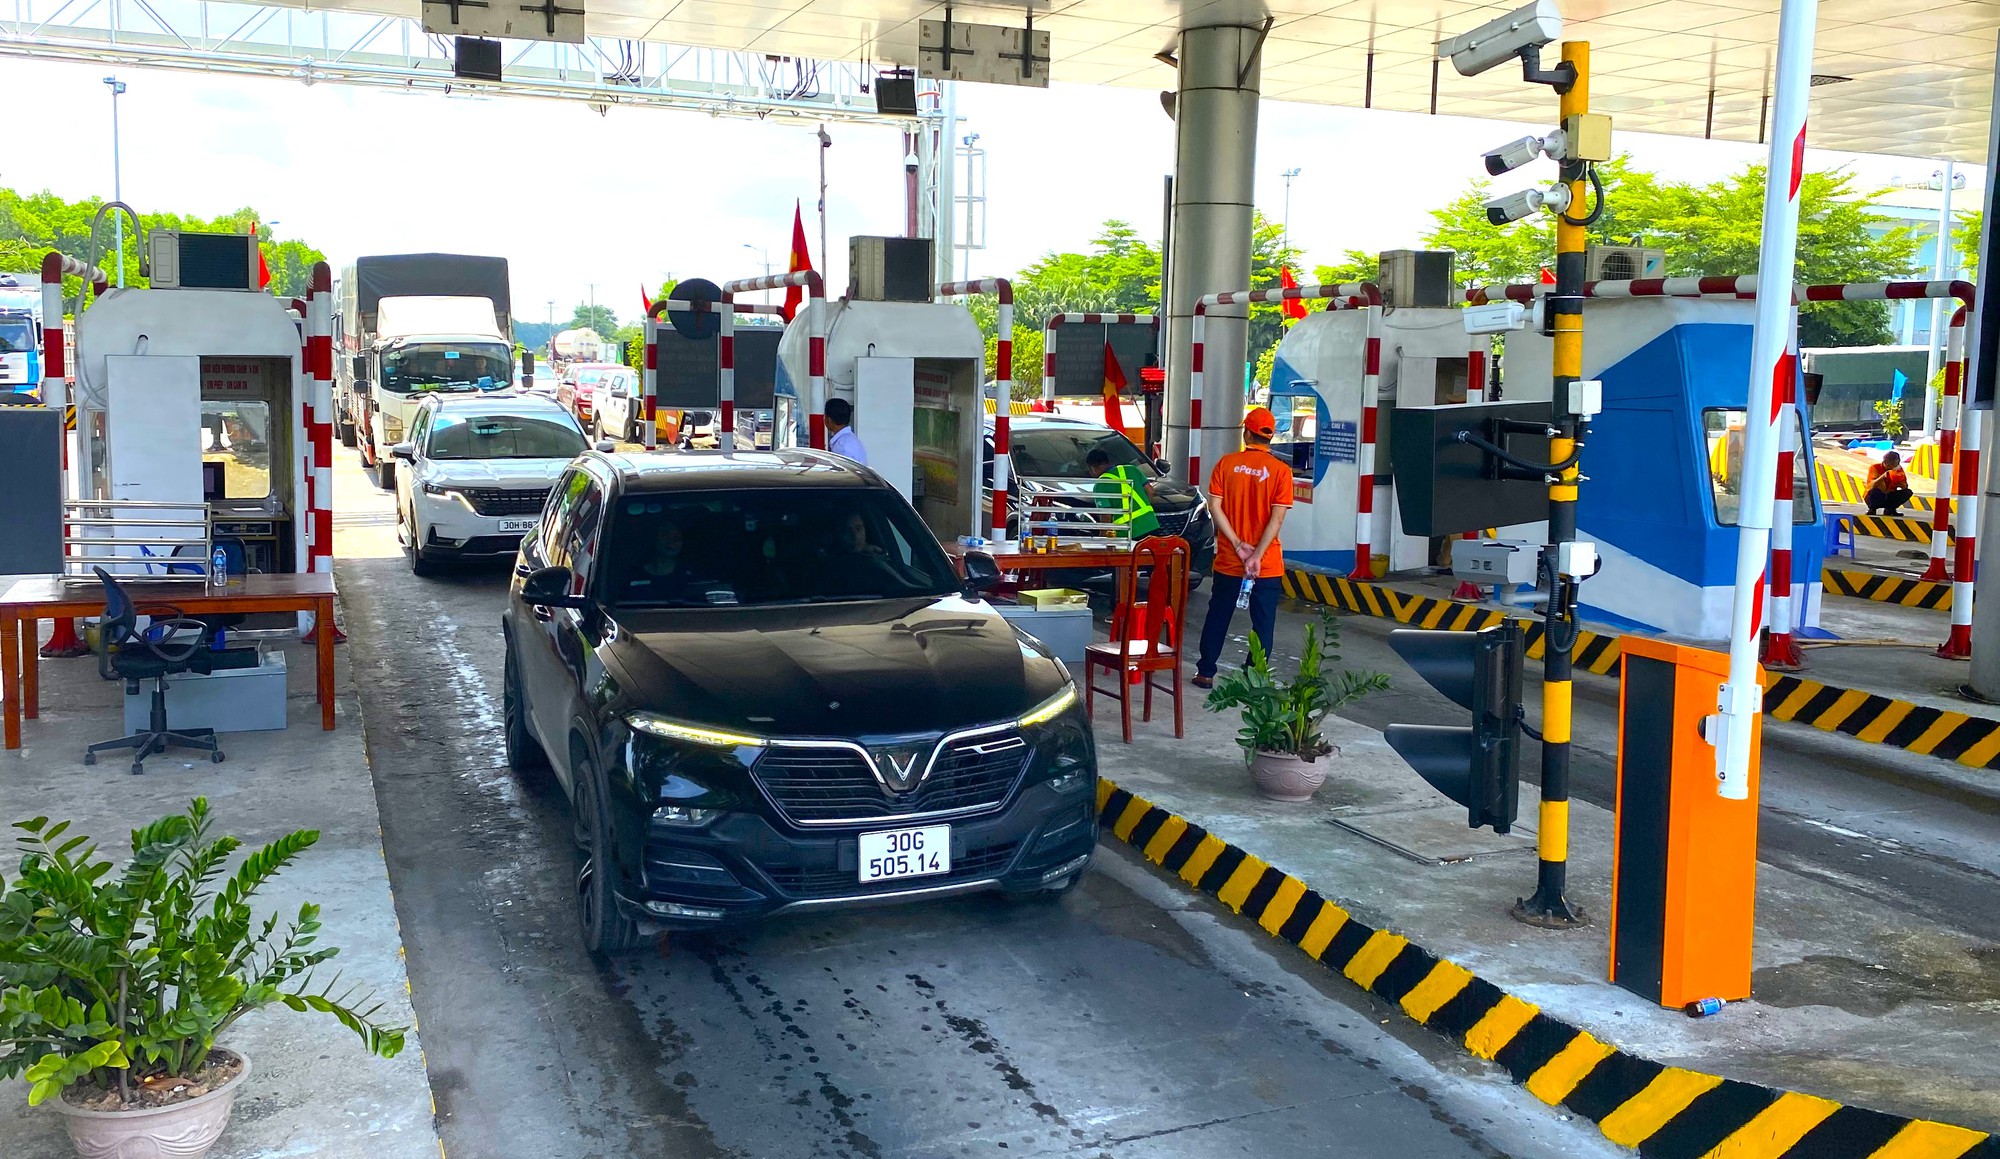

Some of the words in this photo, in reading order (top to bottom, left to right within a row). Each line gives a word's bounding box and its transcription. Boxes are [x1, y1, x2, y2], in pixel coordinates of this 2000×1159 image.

[1234, 464, 1263, 477] ePass
[504, 521, 520, 529] 30H
[886, 832, 924, 853] 30G
[870, 851, 940, 877] 505.14
